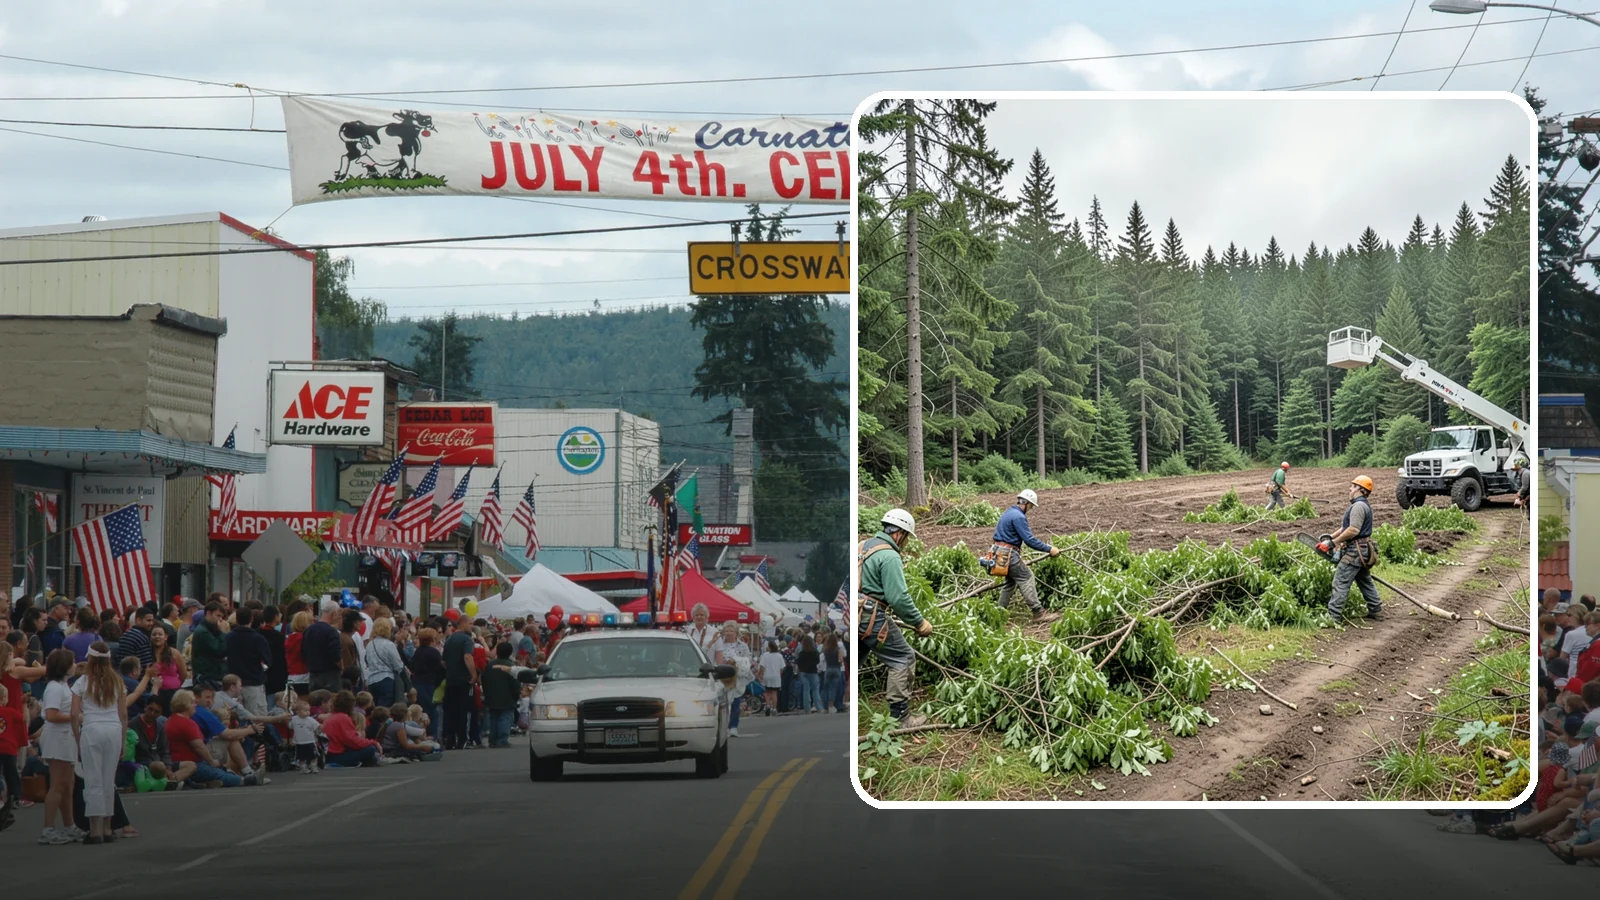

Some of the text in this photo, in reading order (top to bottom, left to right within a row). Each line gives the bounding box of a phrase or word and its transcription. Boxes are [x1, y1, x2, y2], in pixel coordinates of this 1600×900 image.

[481, 141, 604, 192] JULY
[632, 150, 746, 198] 4th.
[697, 254, 850, 280] CROSSWA
[283, 380, 373, 420] ACE
[405, 409, 485, 422] CEDAR LOG
[284, 421, 370, 436] Hardware
[416, 428, 477, 446] Coca-Cola
[353, 467, 387, 481] Simpl
[95, 485, 124, 494] Vincent
[126, 486, 136, 494] de
[138, 486, 154, 494] Paul
